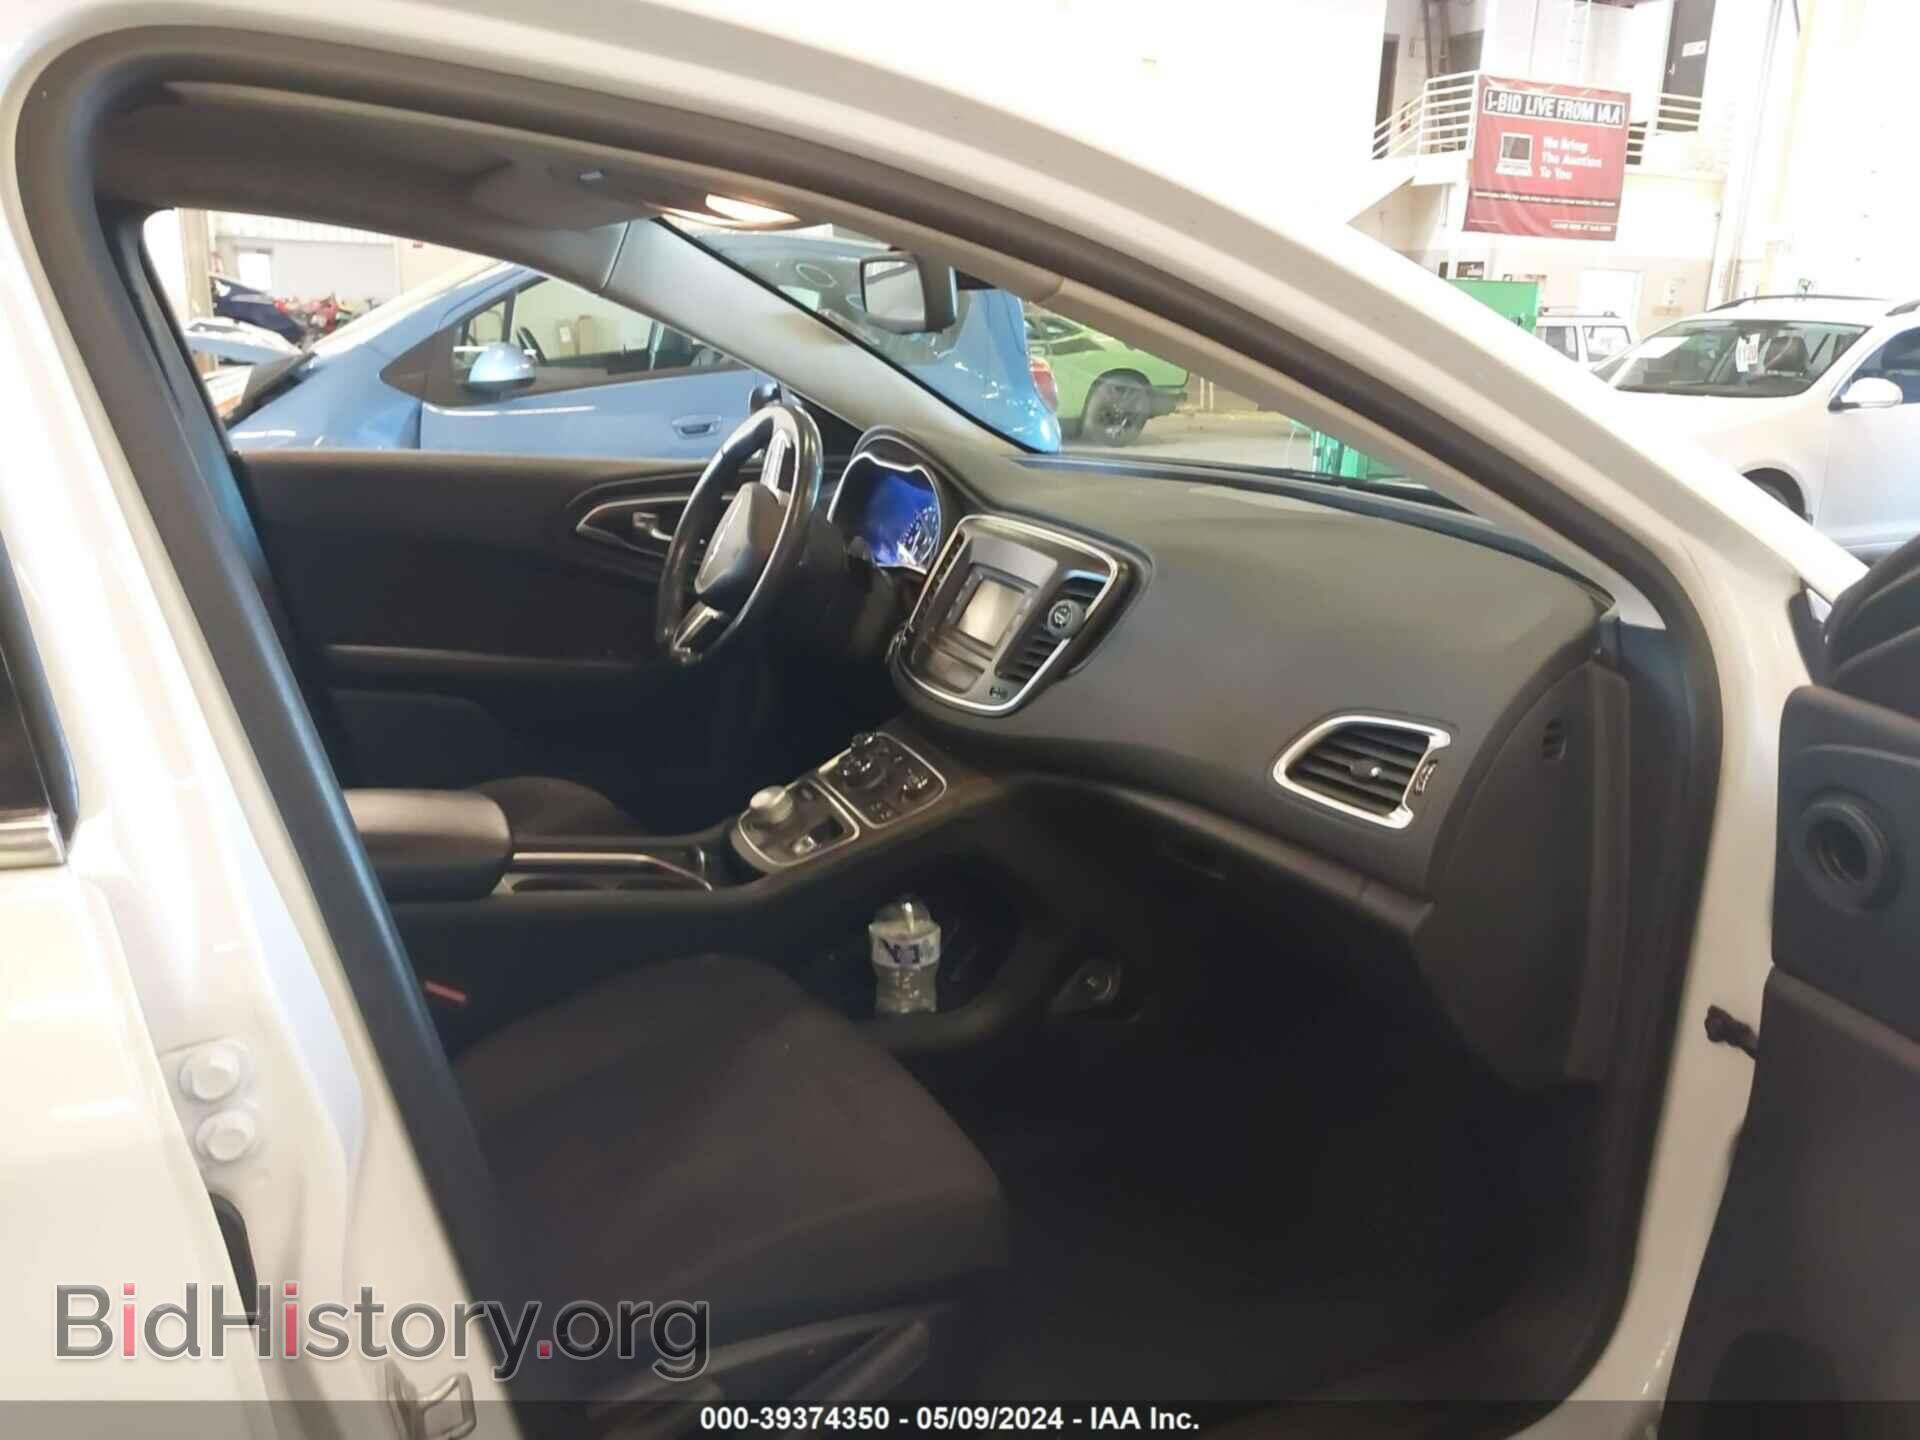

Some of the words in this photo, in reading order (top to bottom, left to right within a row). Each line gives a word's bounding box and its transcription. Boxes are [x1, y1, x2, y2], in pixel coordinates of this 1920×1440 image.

[1524, 95, 1557, 117] LIVE
[1556, 99, 1594, 121] FROM
[1597, 103, 1621, 124] IAA
[1540, 166, 1552, 178] To
